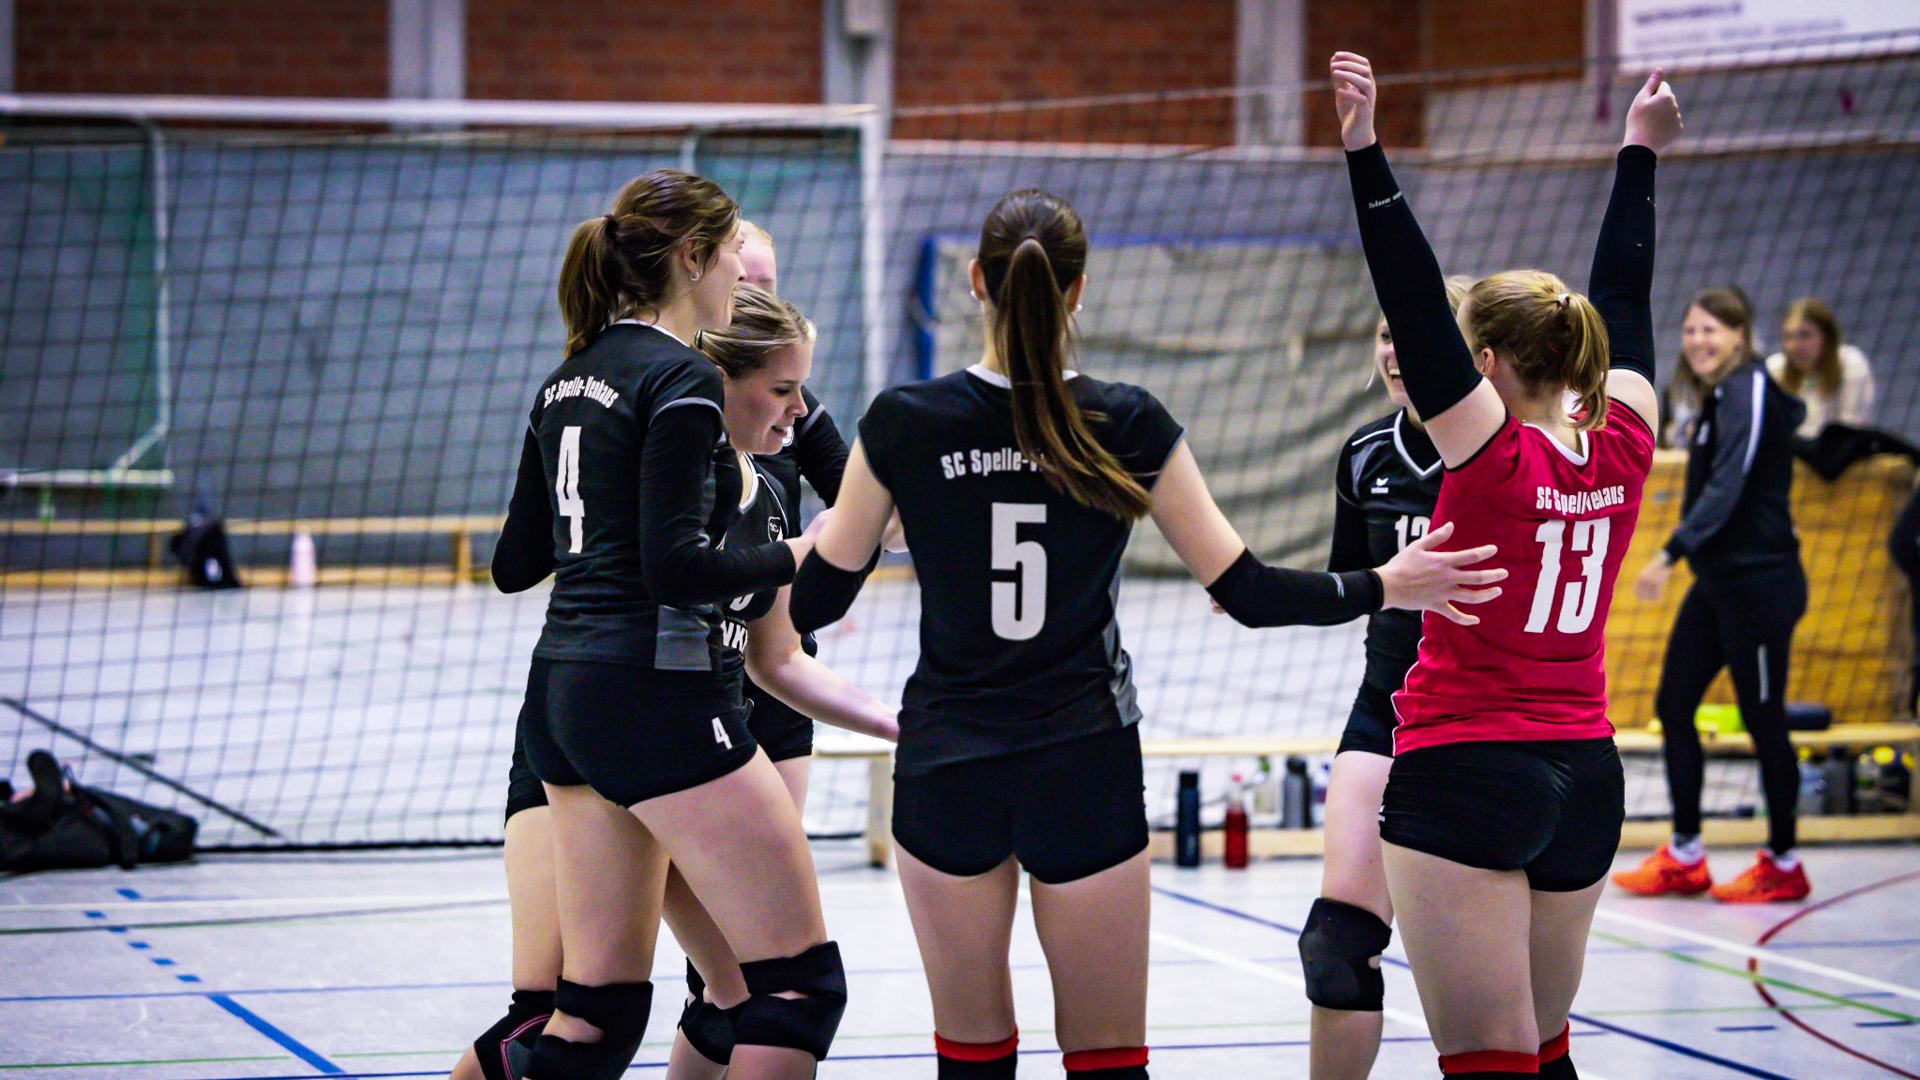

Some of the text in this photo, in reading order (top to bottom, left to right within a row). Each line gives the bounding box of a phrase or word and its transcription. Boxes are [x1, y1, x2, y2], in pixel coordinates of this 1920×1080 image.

[544, 384, 557, 409] SC
[940, 446, 1038, 479] SC Spelle-
[555, 426, 585, 554] 4
[1535, 486, 1553, 510] SC
[991, 501, 1047, 641] 5
[1523, 516, 1610, 634] 13
[711, 716, 733, 750] 4
